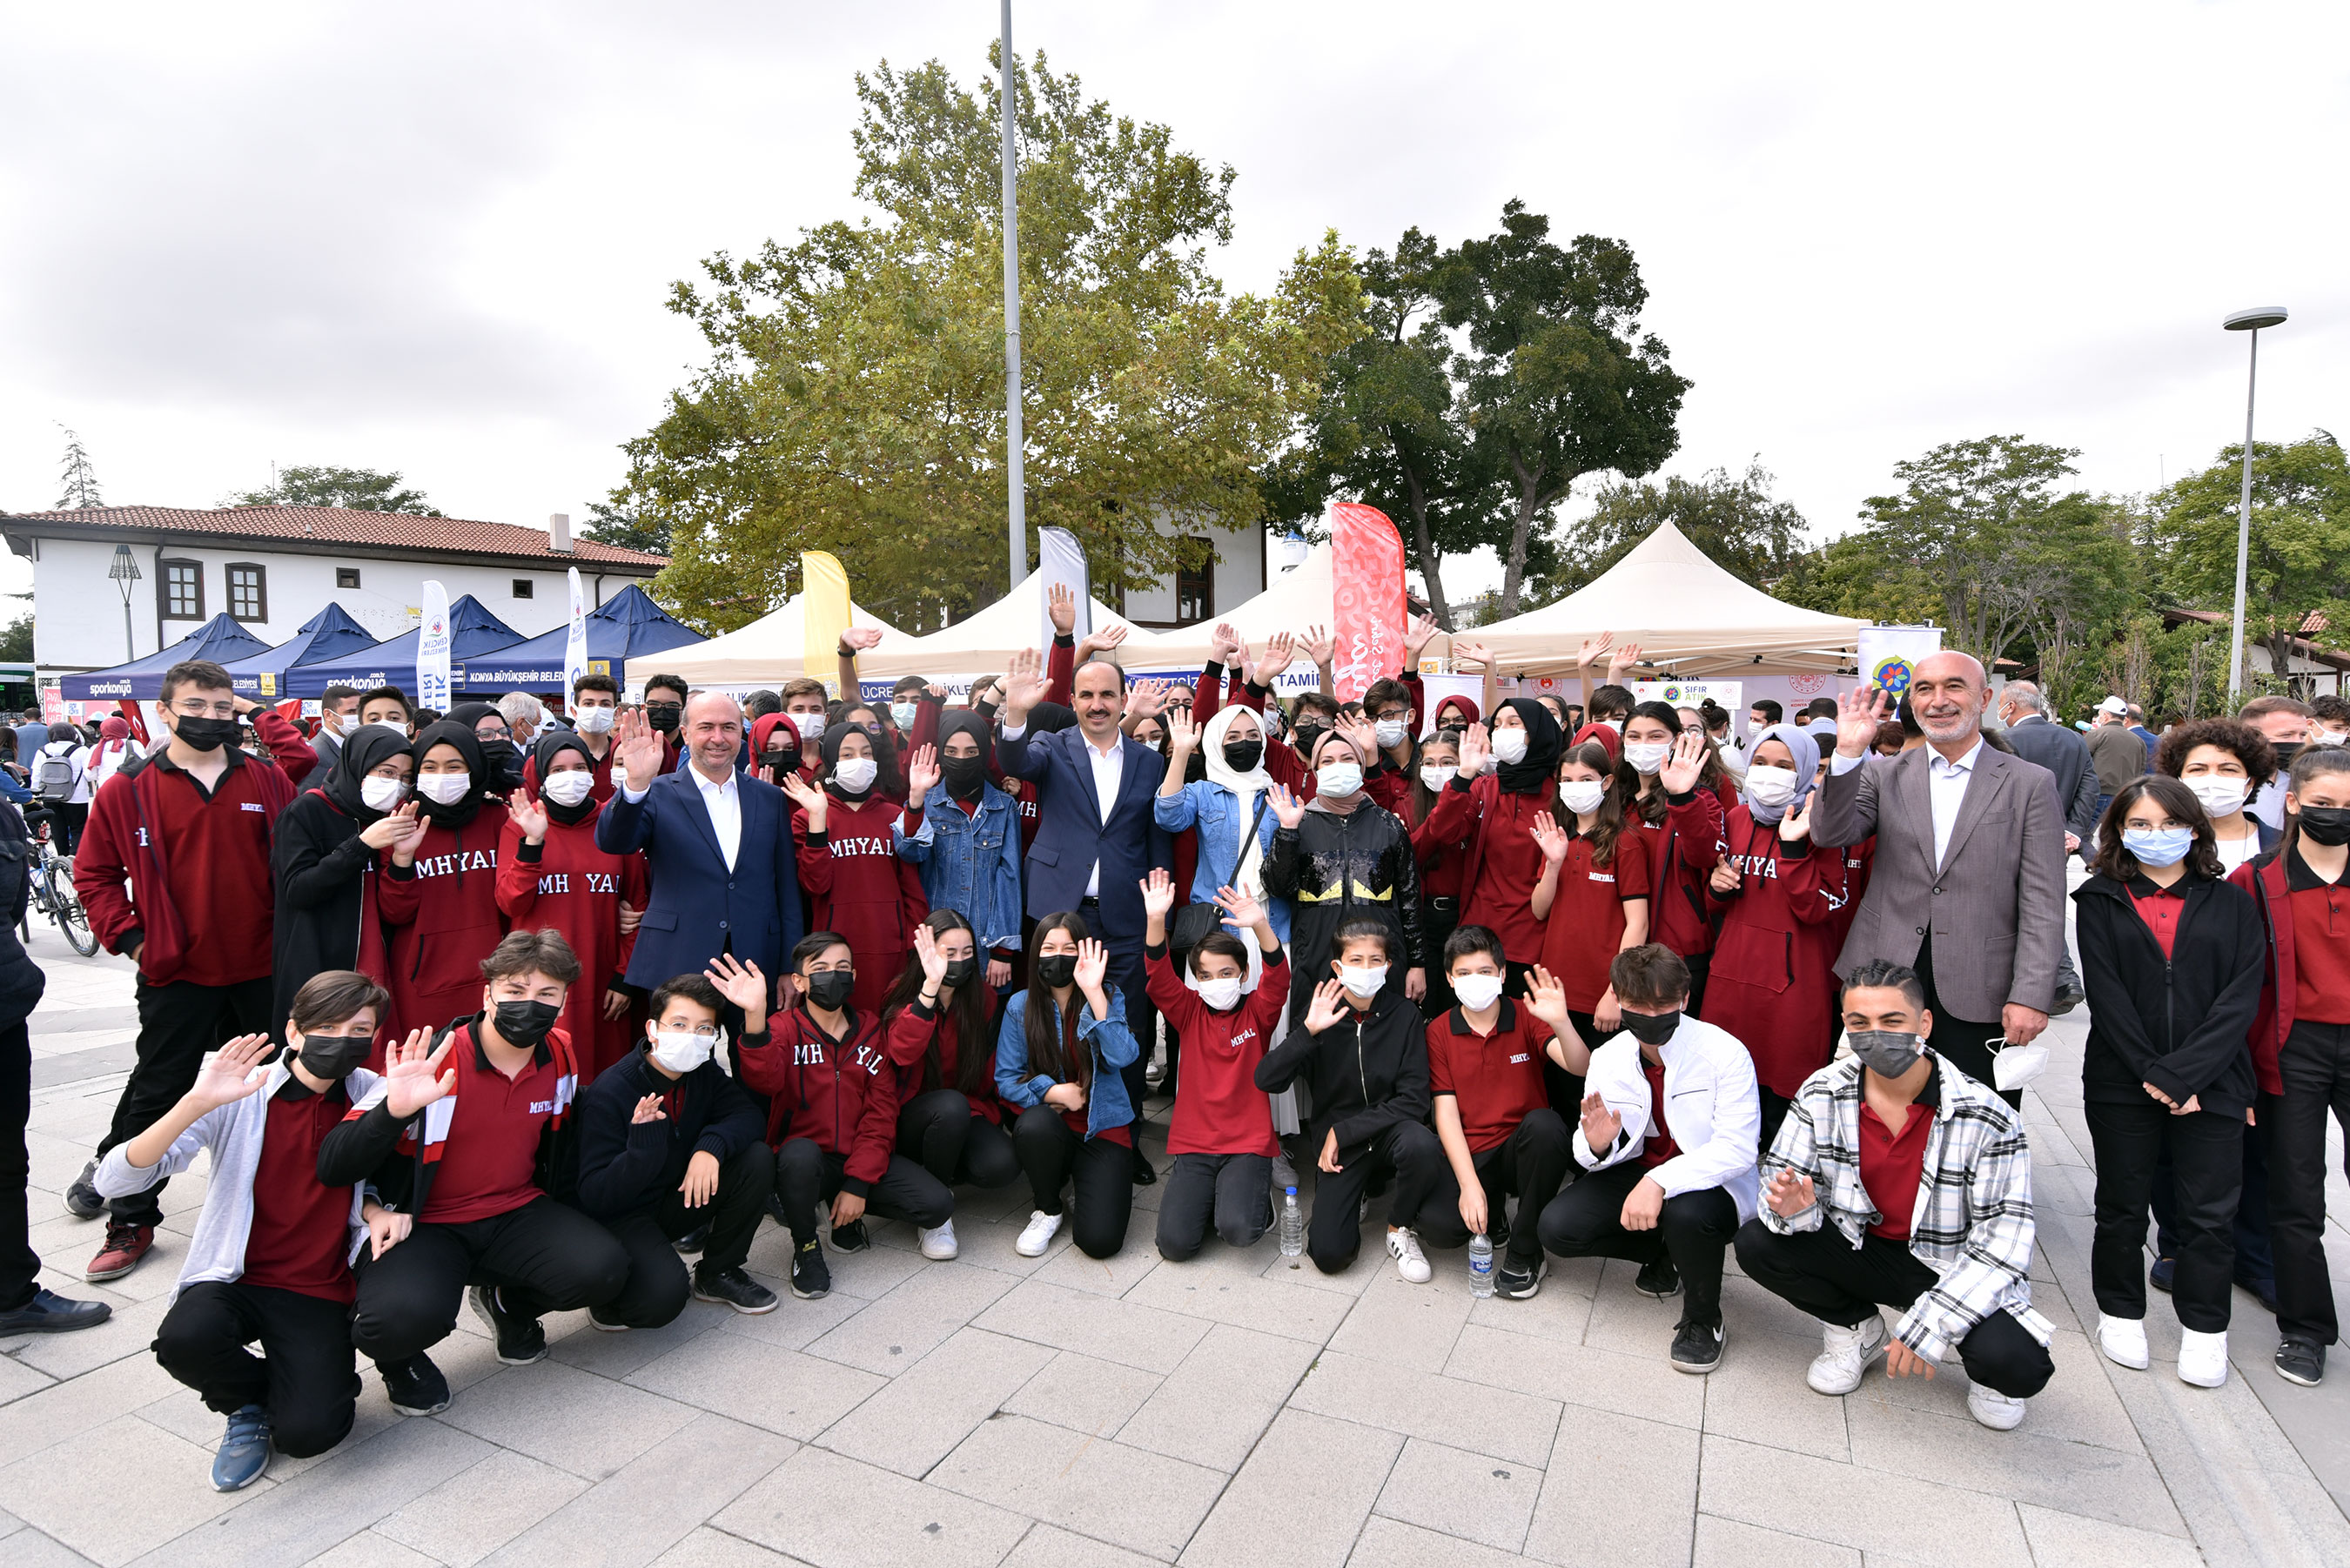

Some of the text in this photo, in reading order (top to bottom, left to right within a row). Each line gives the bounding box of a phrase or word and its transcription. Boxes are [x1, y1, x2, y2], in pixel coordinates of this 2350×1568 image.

[494, 669, 540, 685] BÜYÜKŞEHİR
[540, 671, 564, 682] BELED
[90, 680, 132, 697] sporkonya
[861, 685, 894, 699] ÜCRE
[1017, 801, 1037, 818] MH
[828, 837, 895, 859] MHYAL
[538, 873, 570, 895] MH
[1230, 1028, 1257, 1048] MHAL
[793, 1043, 825, 1066] MH
